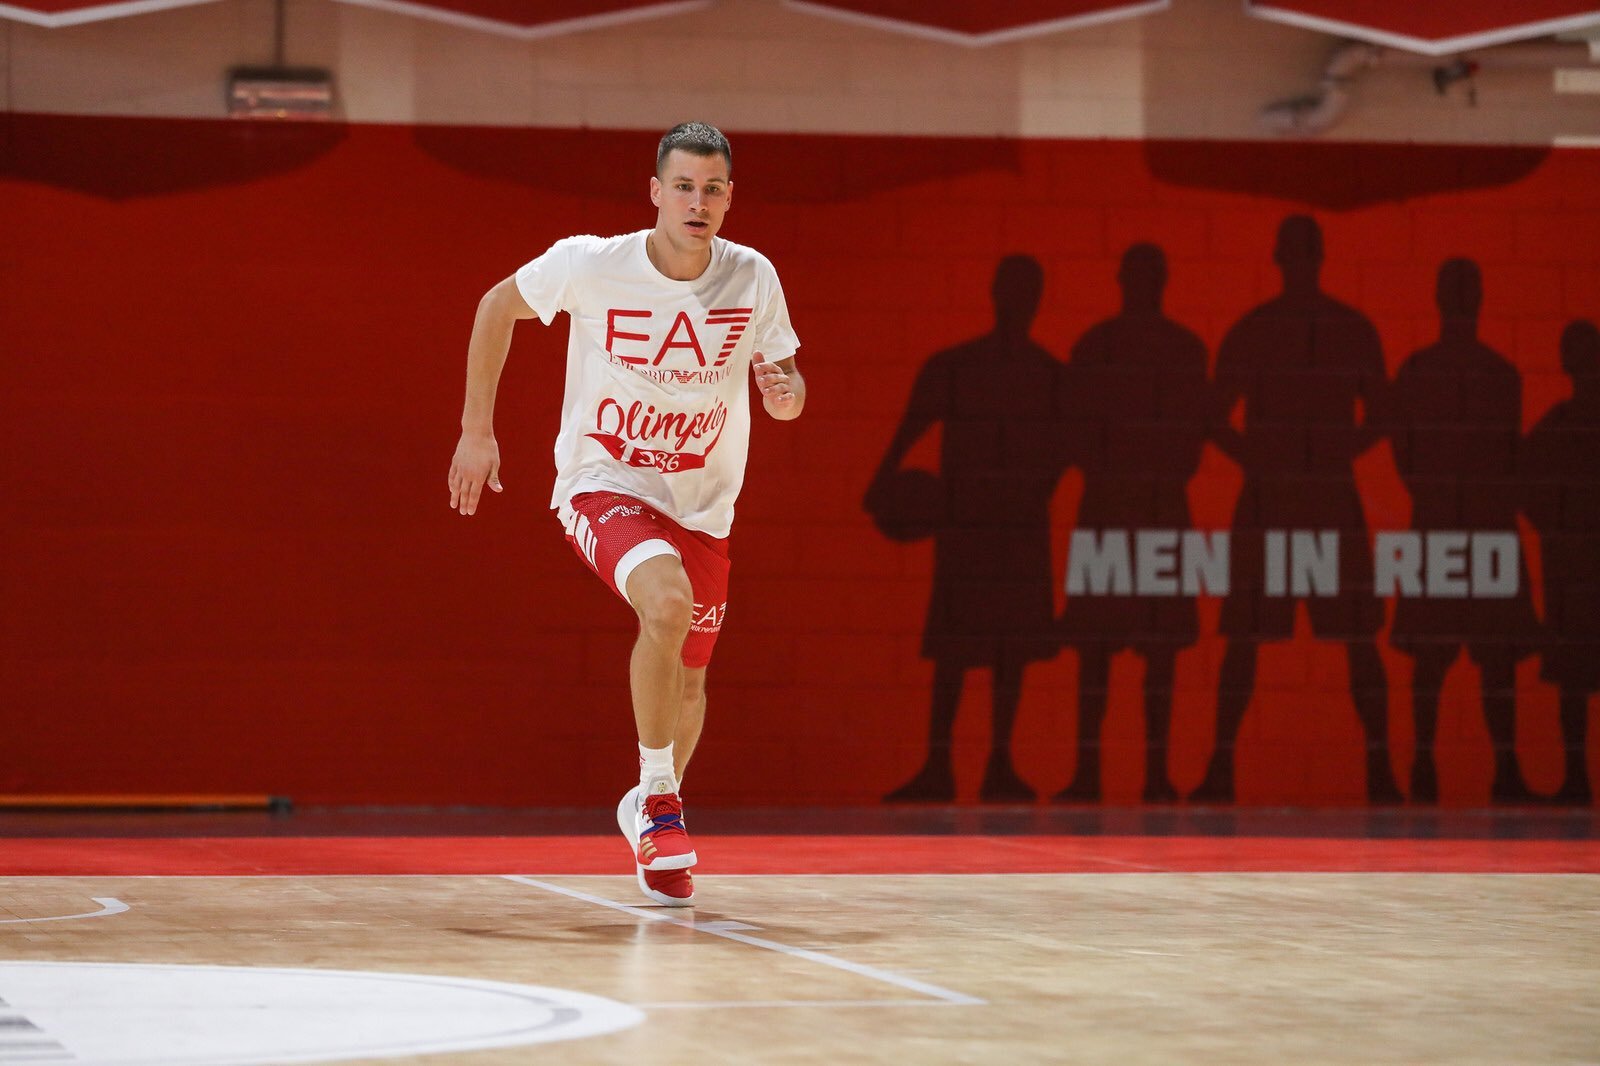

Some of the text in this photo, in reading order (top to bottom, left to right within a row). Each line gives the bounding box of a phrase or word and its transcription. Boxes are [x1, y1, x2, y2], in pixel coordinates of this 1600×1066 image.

[606, 308, 753, 367] EA7
[1066, 529, 1520, 598] MEN IN RED
